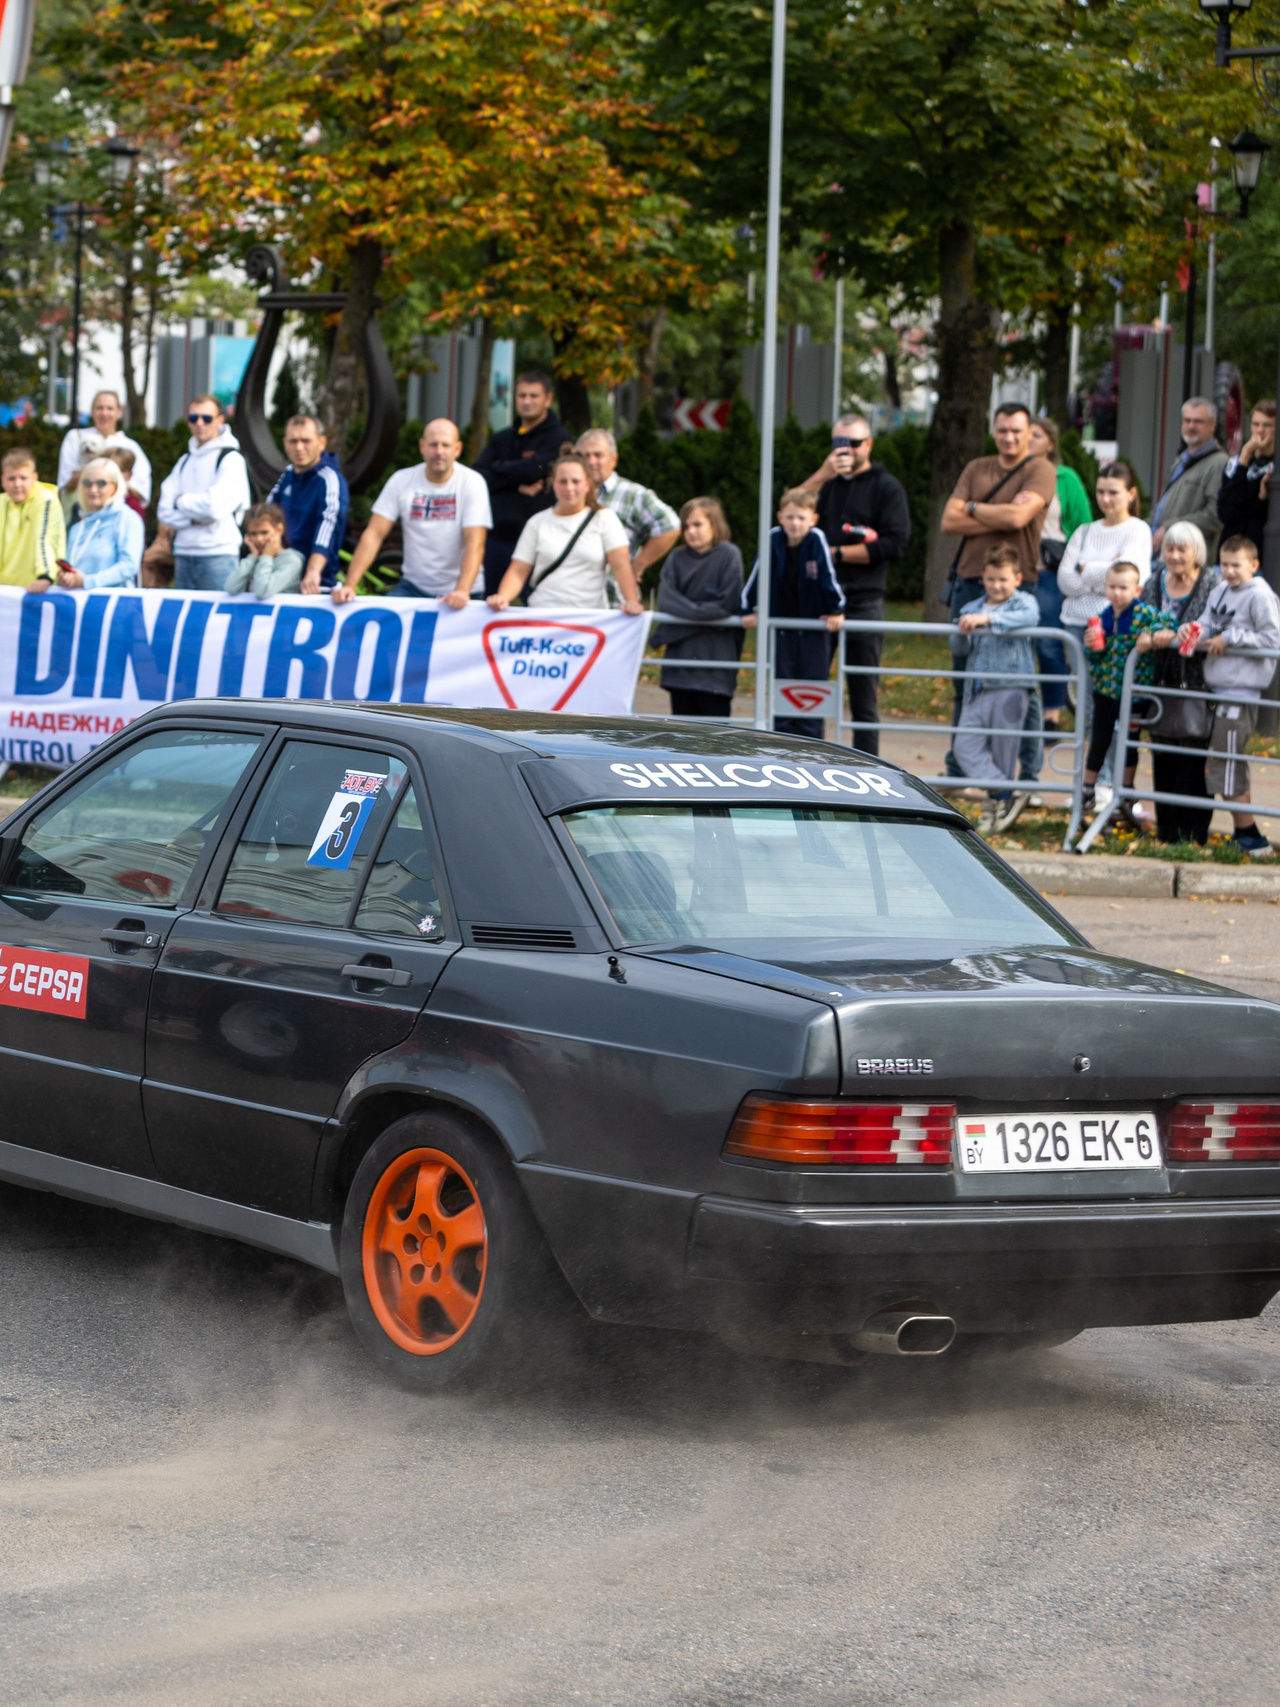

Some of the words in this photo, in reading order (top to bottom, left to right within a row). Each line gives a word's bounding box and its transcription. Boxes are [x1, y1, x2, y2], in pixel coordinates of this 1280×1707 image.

[14, 593, 444, 704] DINITROL
[499, 636, 585, 657] Tuff-Kote
[512, 660, 568, 679] Dinol
[9, 710, 134, 735] НАДЕЖНА
[609, 763, 906, 799] SHELCOLOR
[324, 801, 362, 860] 3
[9, 962, 84, 1003] CEPSA
[856, 1058, 934, 1075] BRABUS
[966, 1147, 984, 1164] BY
[996, 1120, 1070, 1164] 1326
[1079, 1119, 1154, 1162] EK-6
